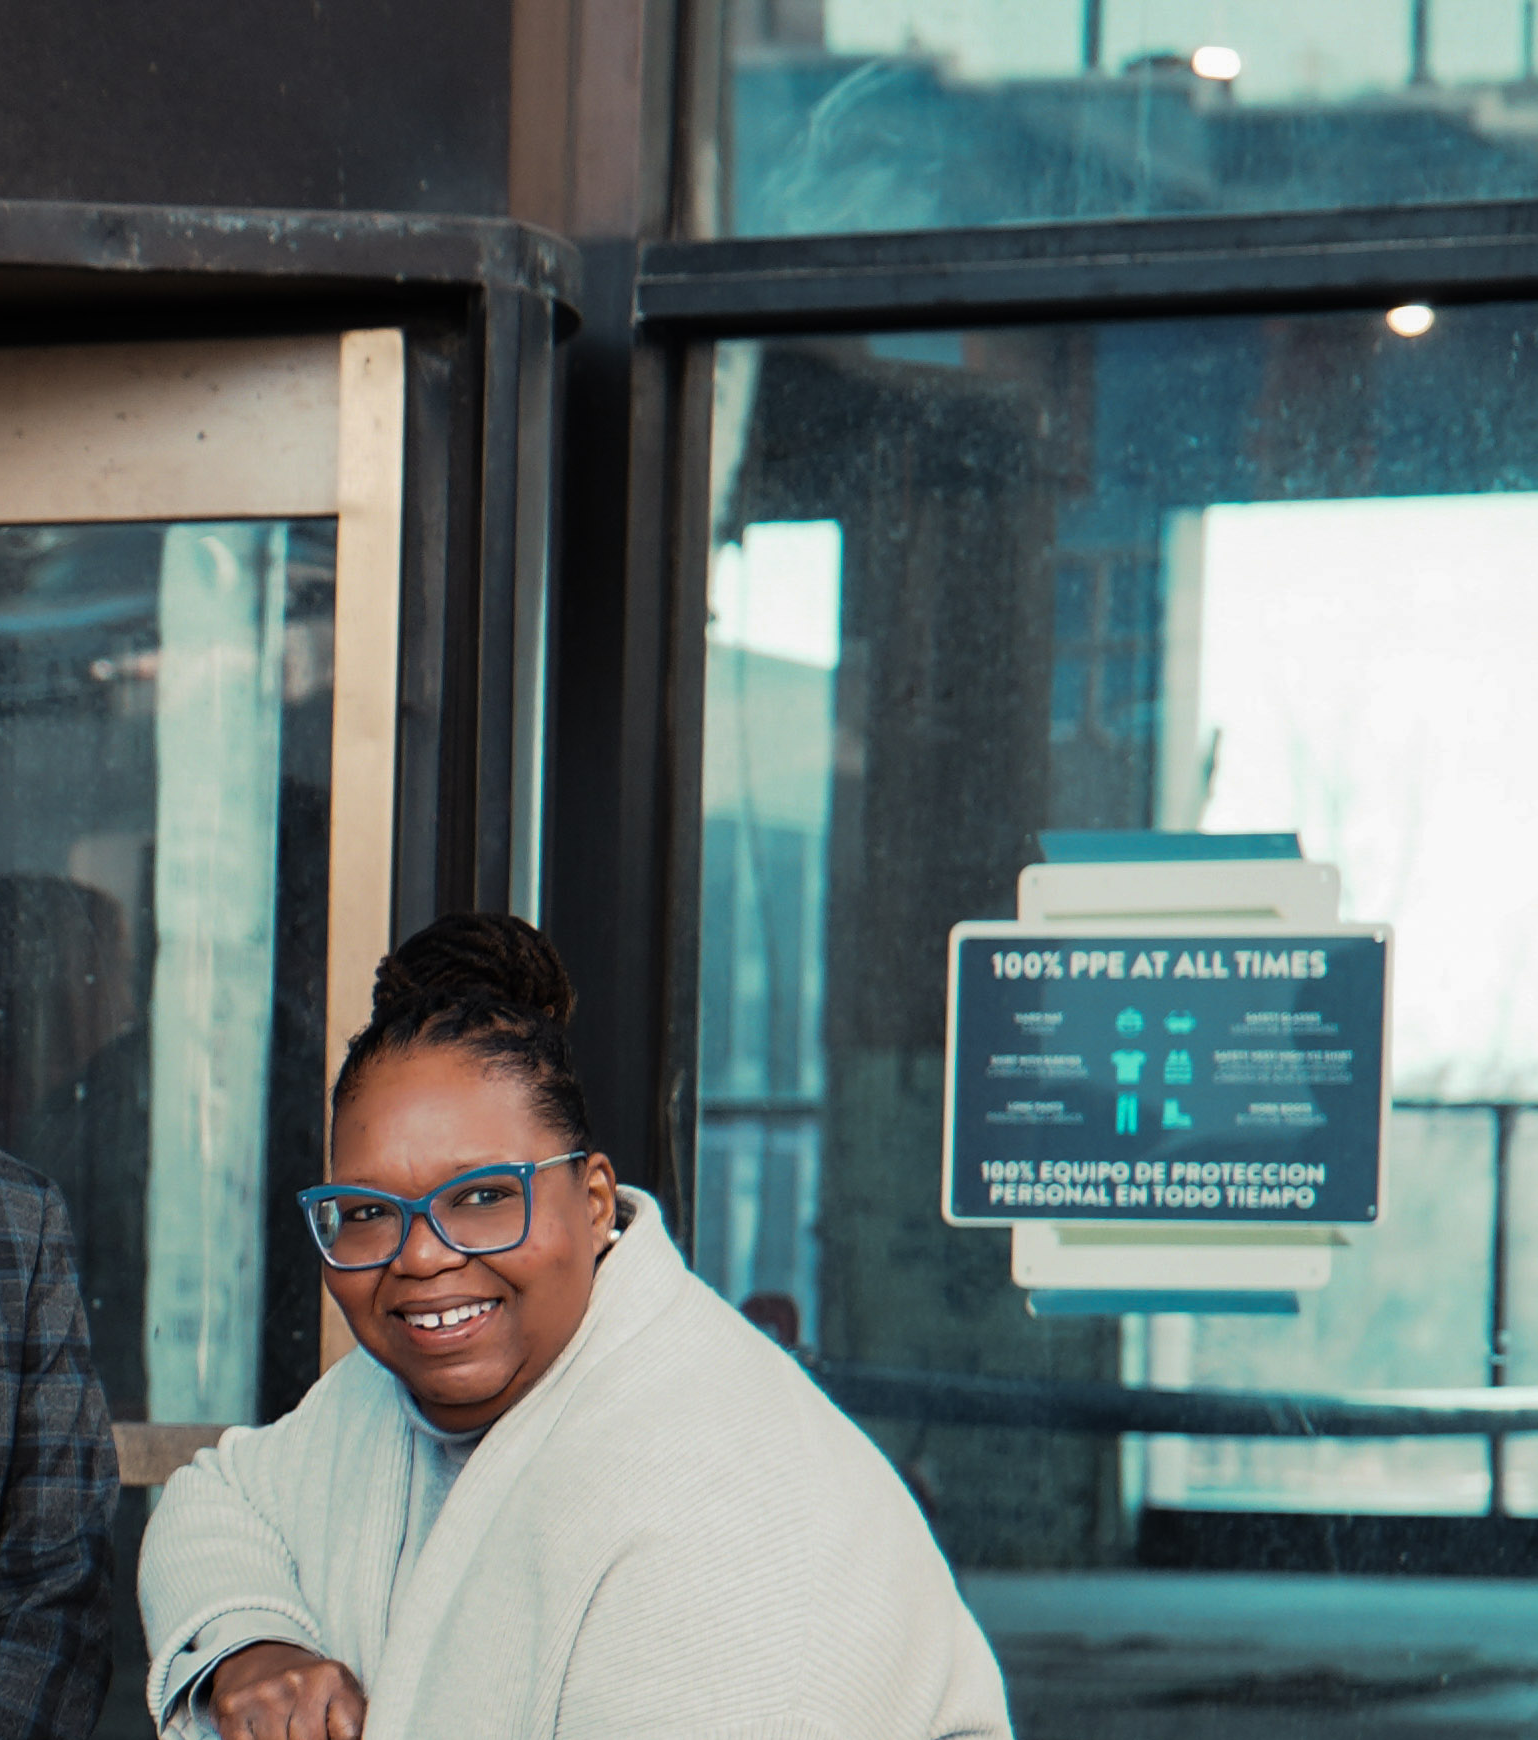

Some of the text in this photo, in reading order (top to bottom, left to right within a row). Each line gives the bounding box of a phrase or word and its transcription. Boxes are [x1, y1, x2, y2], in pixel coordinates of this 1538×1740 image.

[991, 950, 1328, 979] 100% PPE AT ALL TIMES
[981, 1160, 1326, 1185] 100% EQUIPO DE PROTECCION
[989, 1183, 1315, 1209] PERSONAL EN TODO TIEMPO
